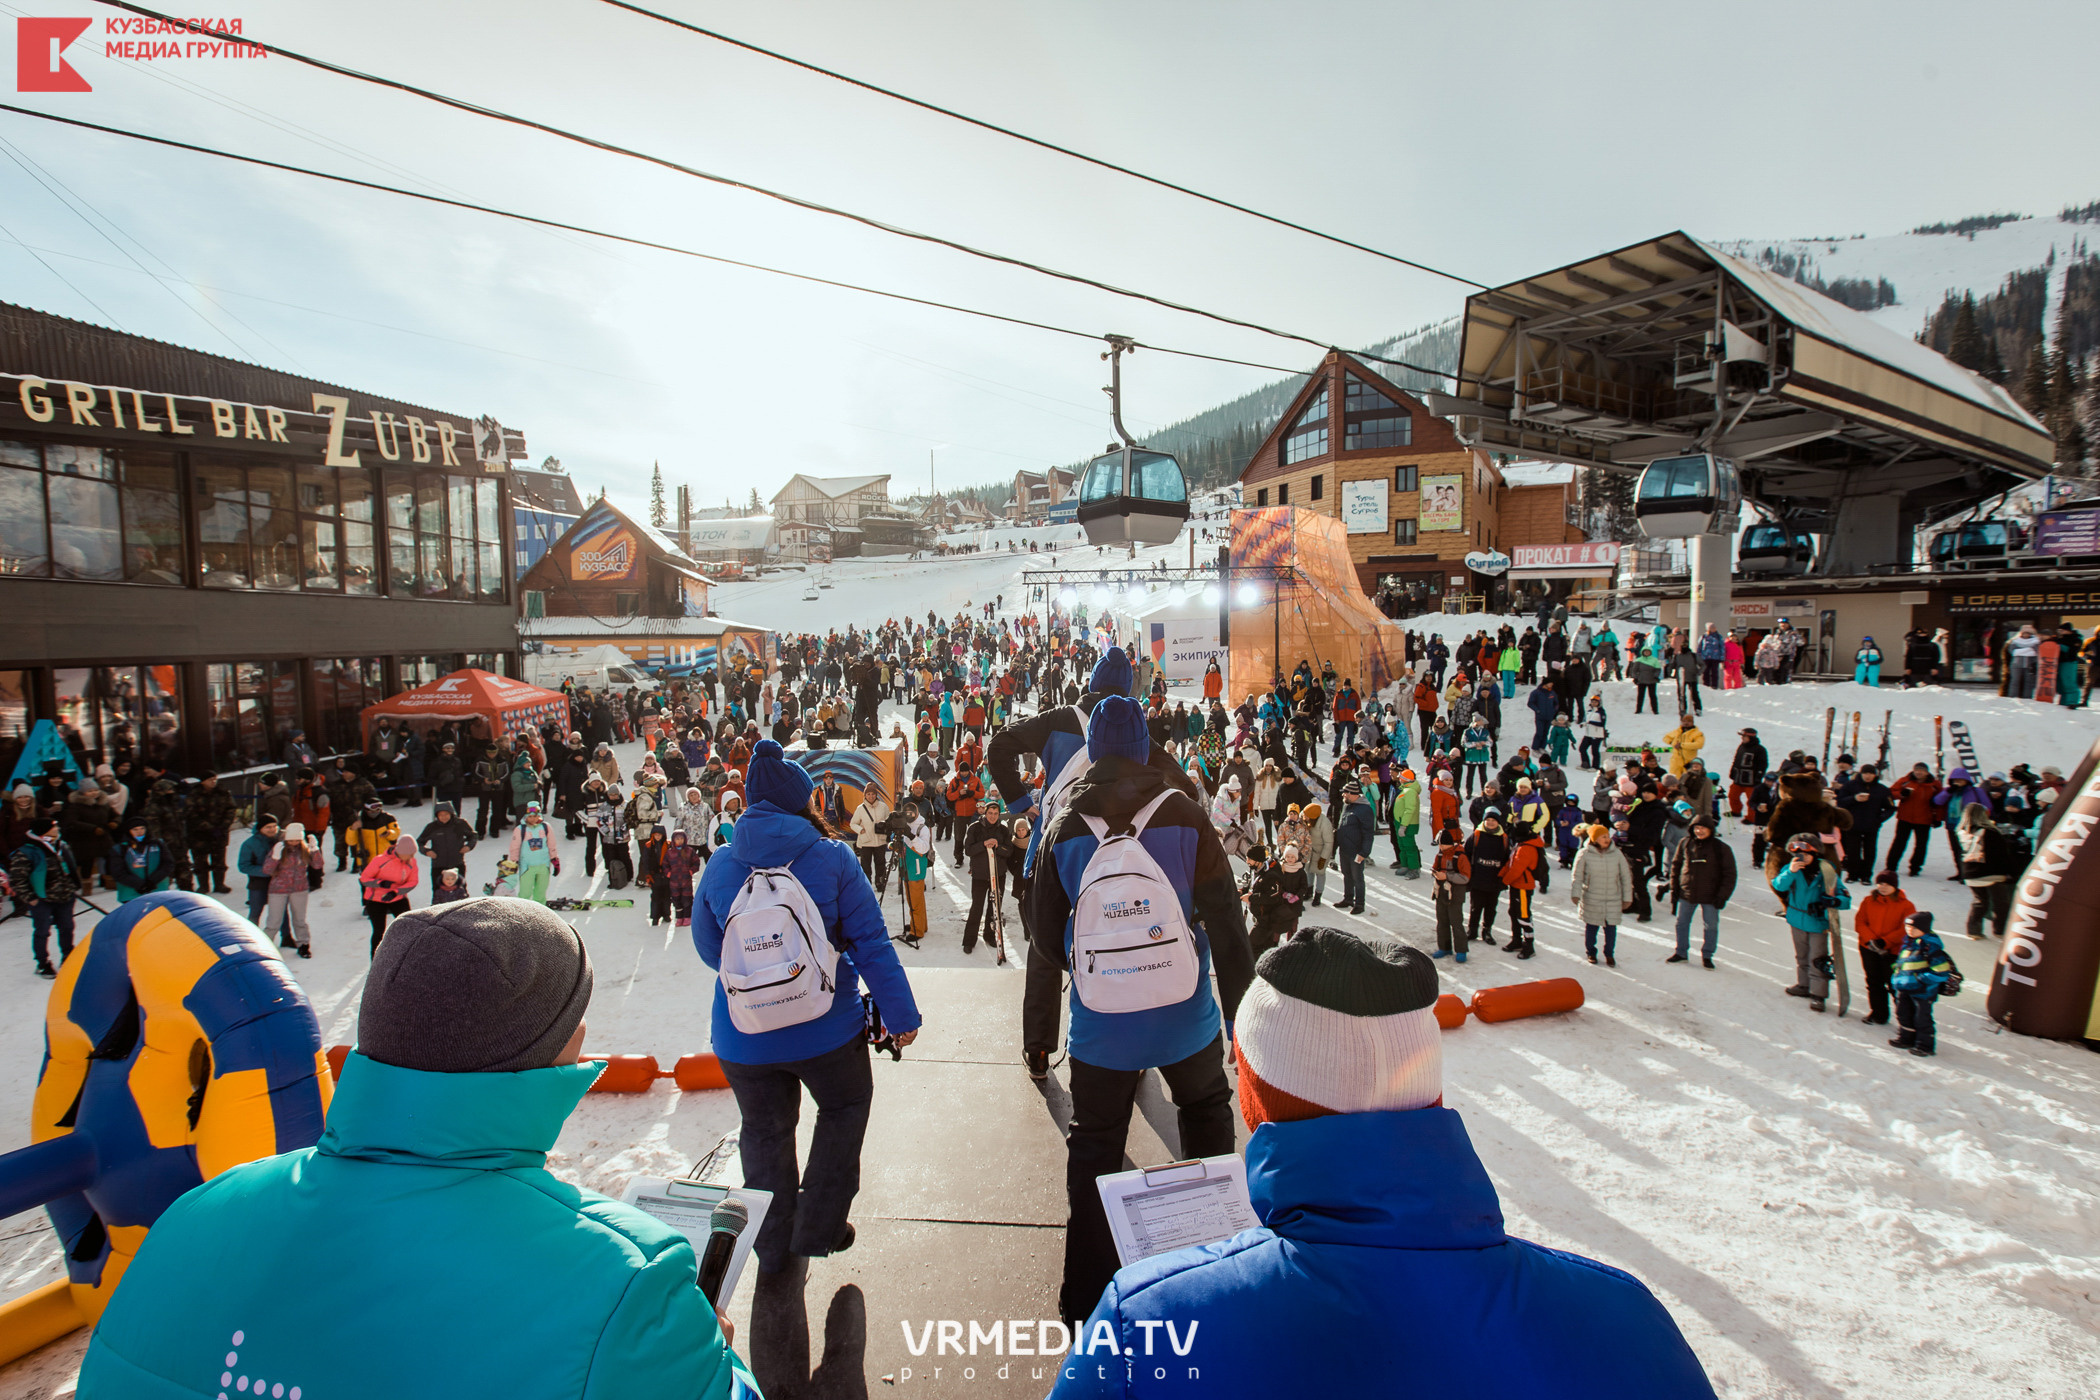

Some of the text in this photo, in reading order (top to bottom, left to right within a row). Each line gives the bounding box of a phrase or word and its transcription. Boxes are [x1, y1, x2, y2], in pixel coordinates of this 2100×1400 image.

[19, 379, 462, 468] GRILL BAR ZUBR
[690, 529, 729, 541] АТОК
[580, 552, 602, 562] 300
[1515, 546, 1574, 565] ПРОКАТ
[580, 562, 630, 573] КУЗБАСС
[1467, 557, 1509, 569] Сугроб
[1733, 604, 1769, 615] КАССЫ
[1102, 901, 1127, 911] VISIT
[2000, 812, 2100, 988] ТОМСКАЯ
[1103, 906, 1151, 919] KUZBASS
[744, 935, 765, 945] VISIT
[1101, 960, 1173, 976] #ОТКРОЙКУЗБАСС
